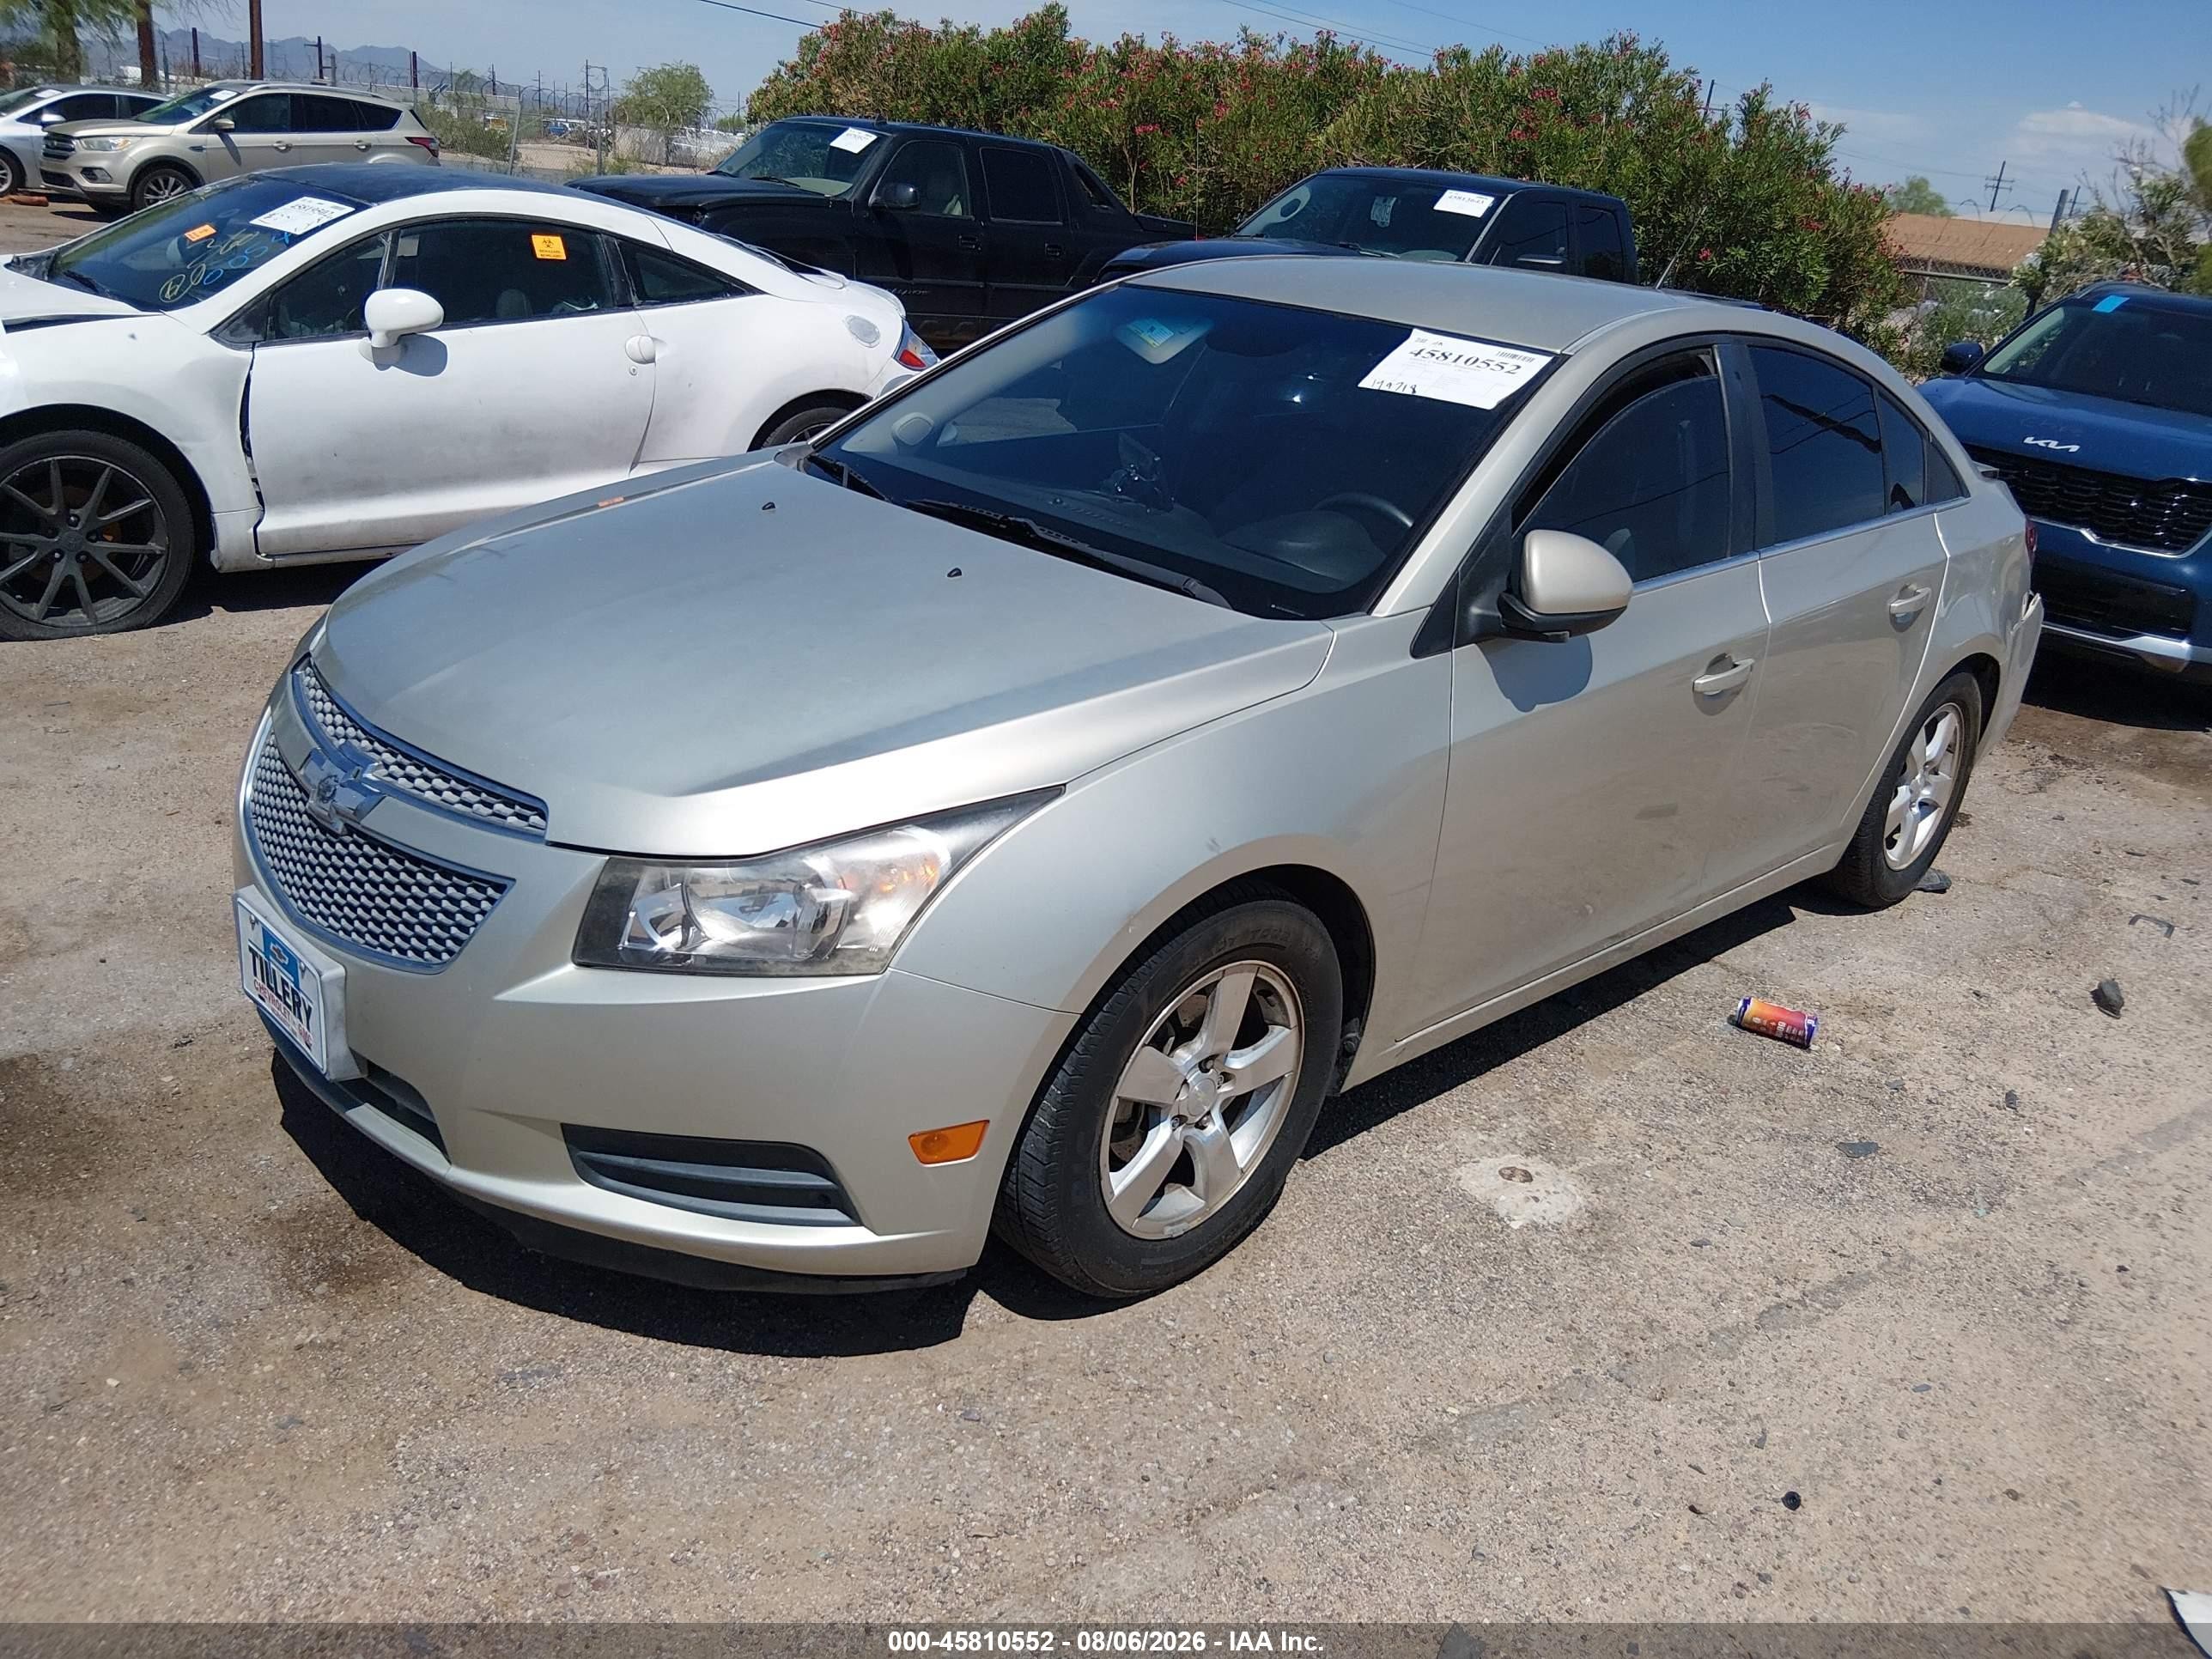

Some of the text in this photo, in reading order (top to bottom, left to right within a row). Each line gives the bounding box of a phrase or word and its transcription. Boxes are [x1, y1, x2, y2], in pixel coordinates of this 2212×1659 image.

[1409, 347, 1522, 375] 45810552
[248, 945, 313, 1032] TILLERY
[253, 977, 291, 1022] CHEVROLET
